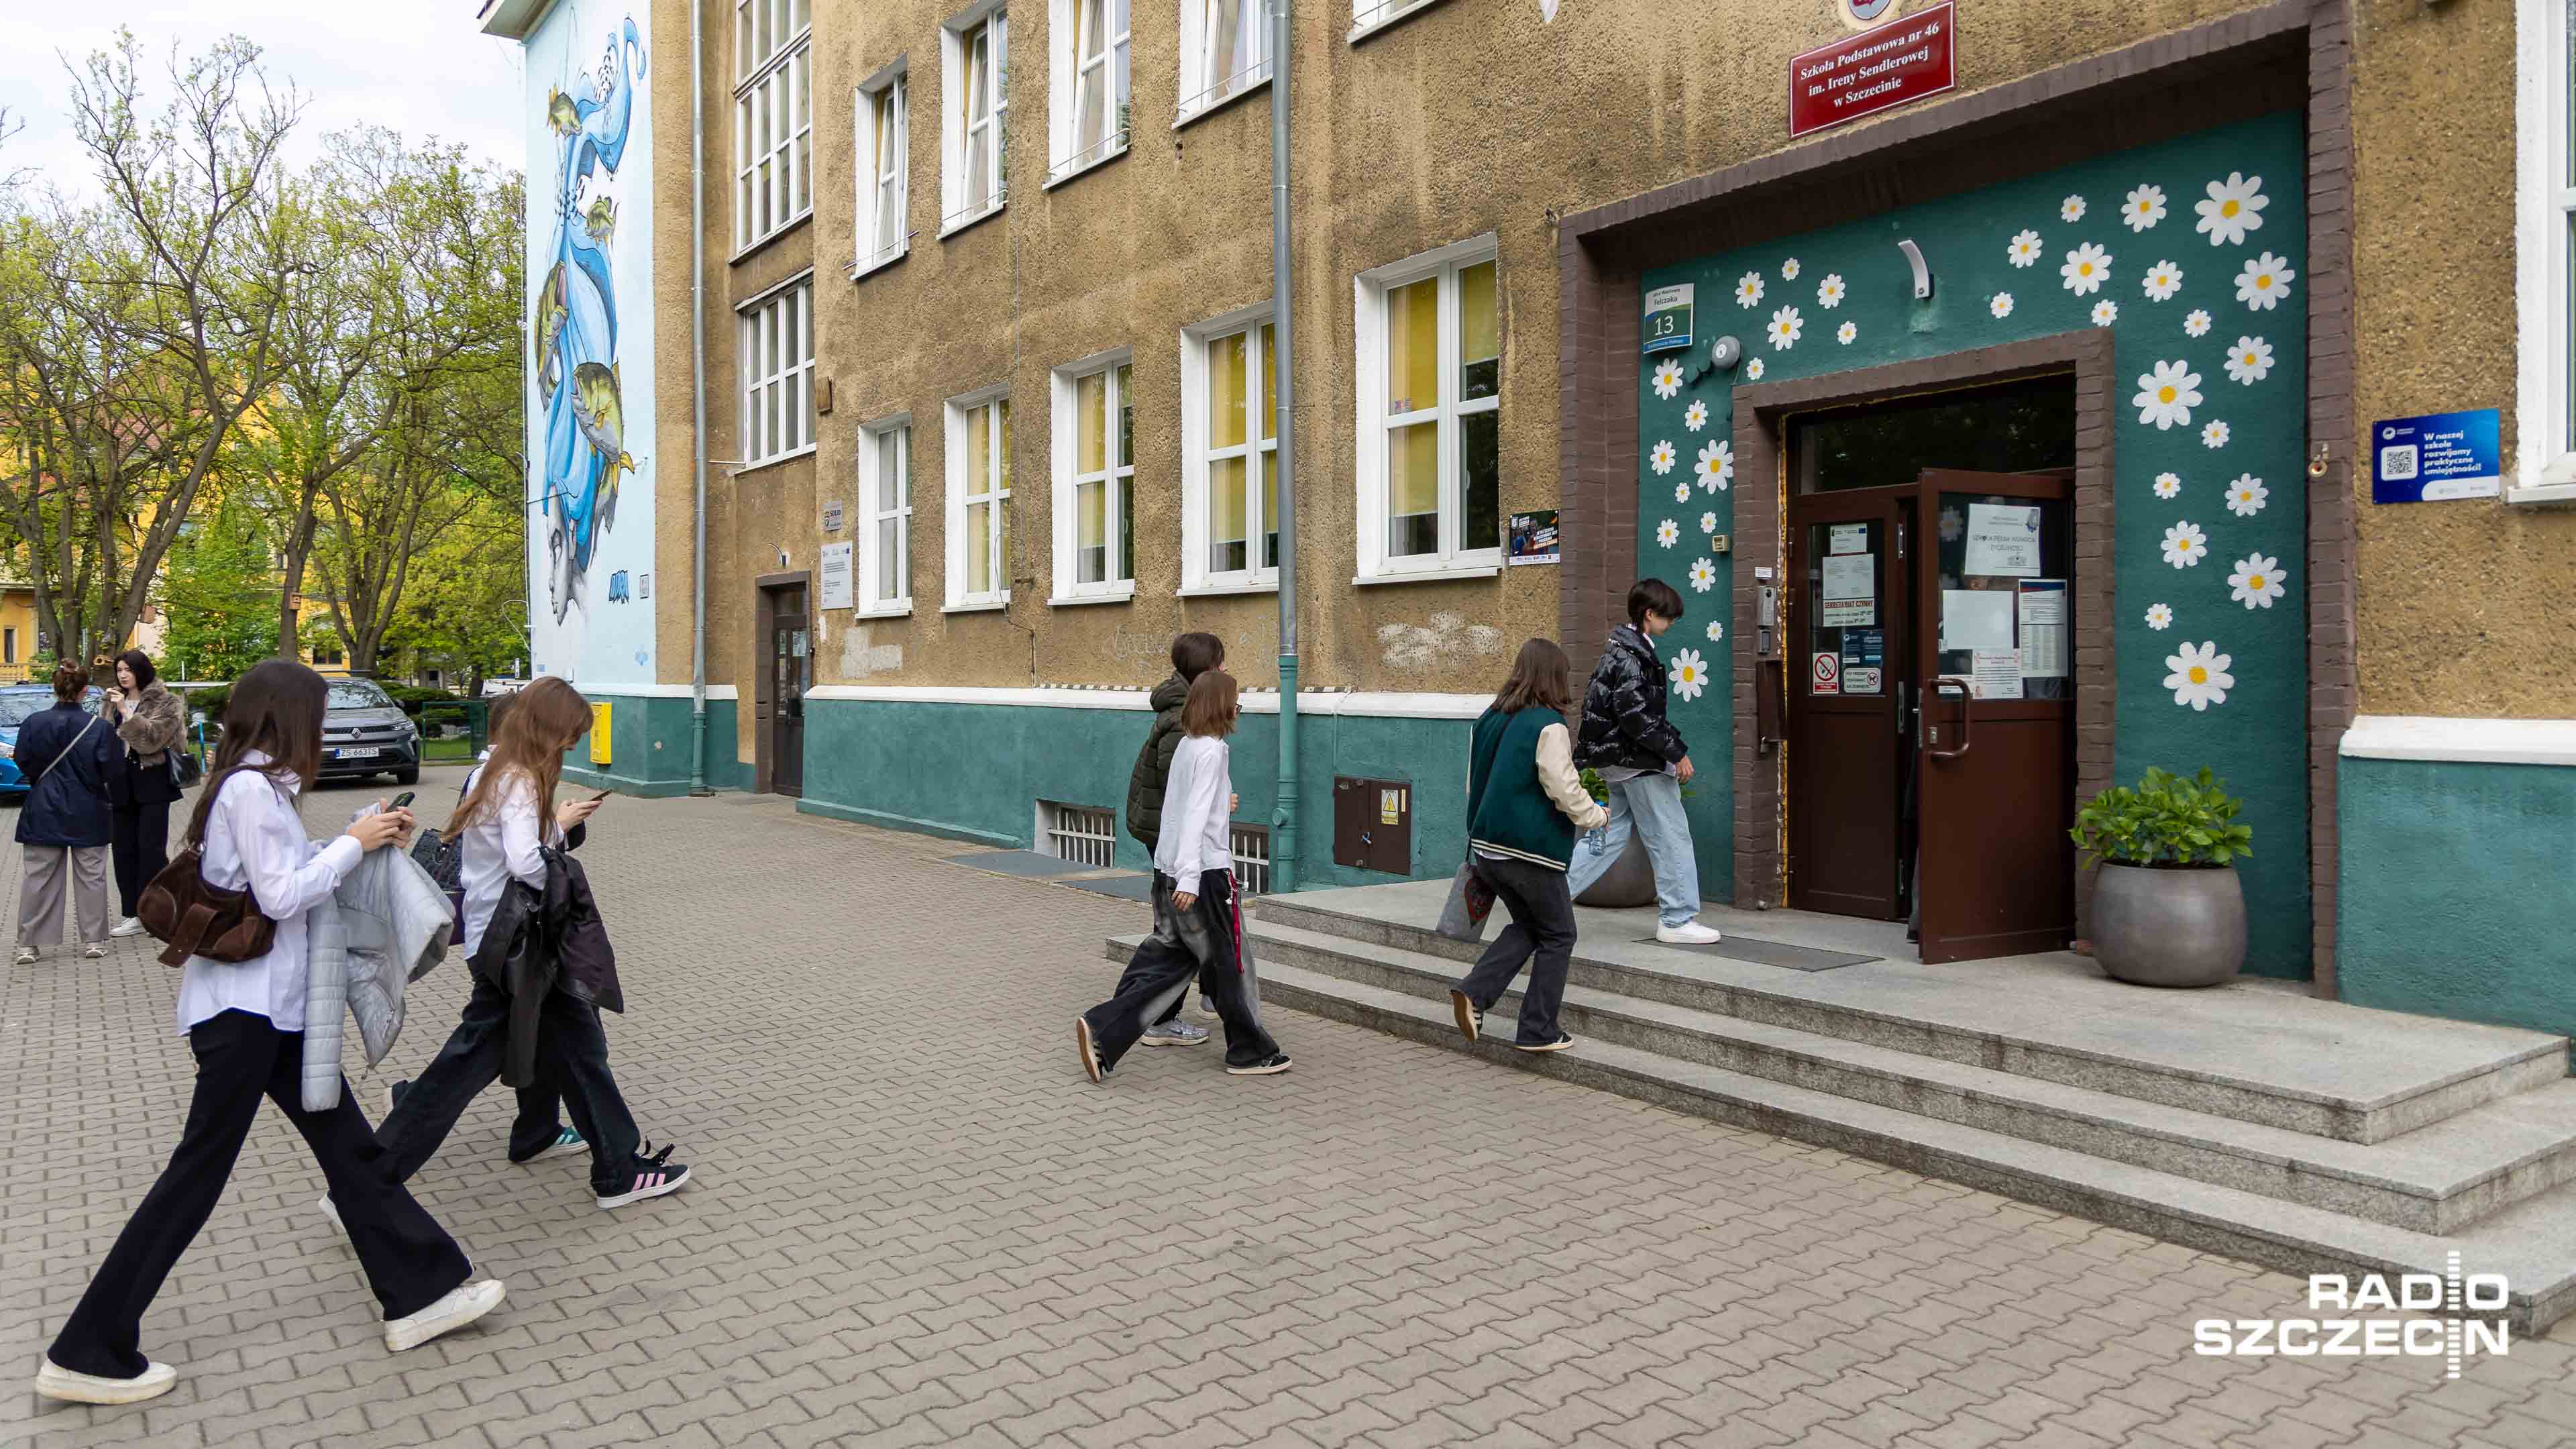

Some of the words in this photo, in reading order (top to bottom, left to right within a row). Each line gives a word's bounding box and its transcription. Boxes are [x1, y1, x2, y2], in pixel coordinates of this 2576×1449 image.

[1801, 60, 1835, 80] Szkoła
[1837, 38, 1905, 66] Podstawowa
[1907, 30, 1923, 43] nr
[1925, 21, 1939, 38] 46
[1809, 84, 1825, 97] im.
[1828, 72, 1856, 91] Ireny
[1859, 45, 1929, 79] Sendlerowej
[1833, 97, 1843, 107] w
[1845, 76, 1902, 105] Szczecinie
[1654, 295, 1678, 307] Felczaka
[1655, 315, 1674, 336] 13
[2423, 433, 2435, 441] W
[2436, 430, 2464, 440] naszej
[2424, 440, 2452, 449] szkole
[2424, 448, 2471, 459] rozwijamy
[2424, 456, 2474, 468] praktyczne
